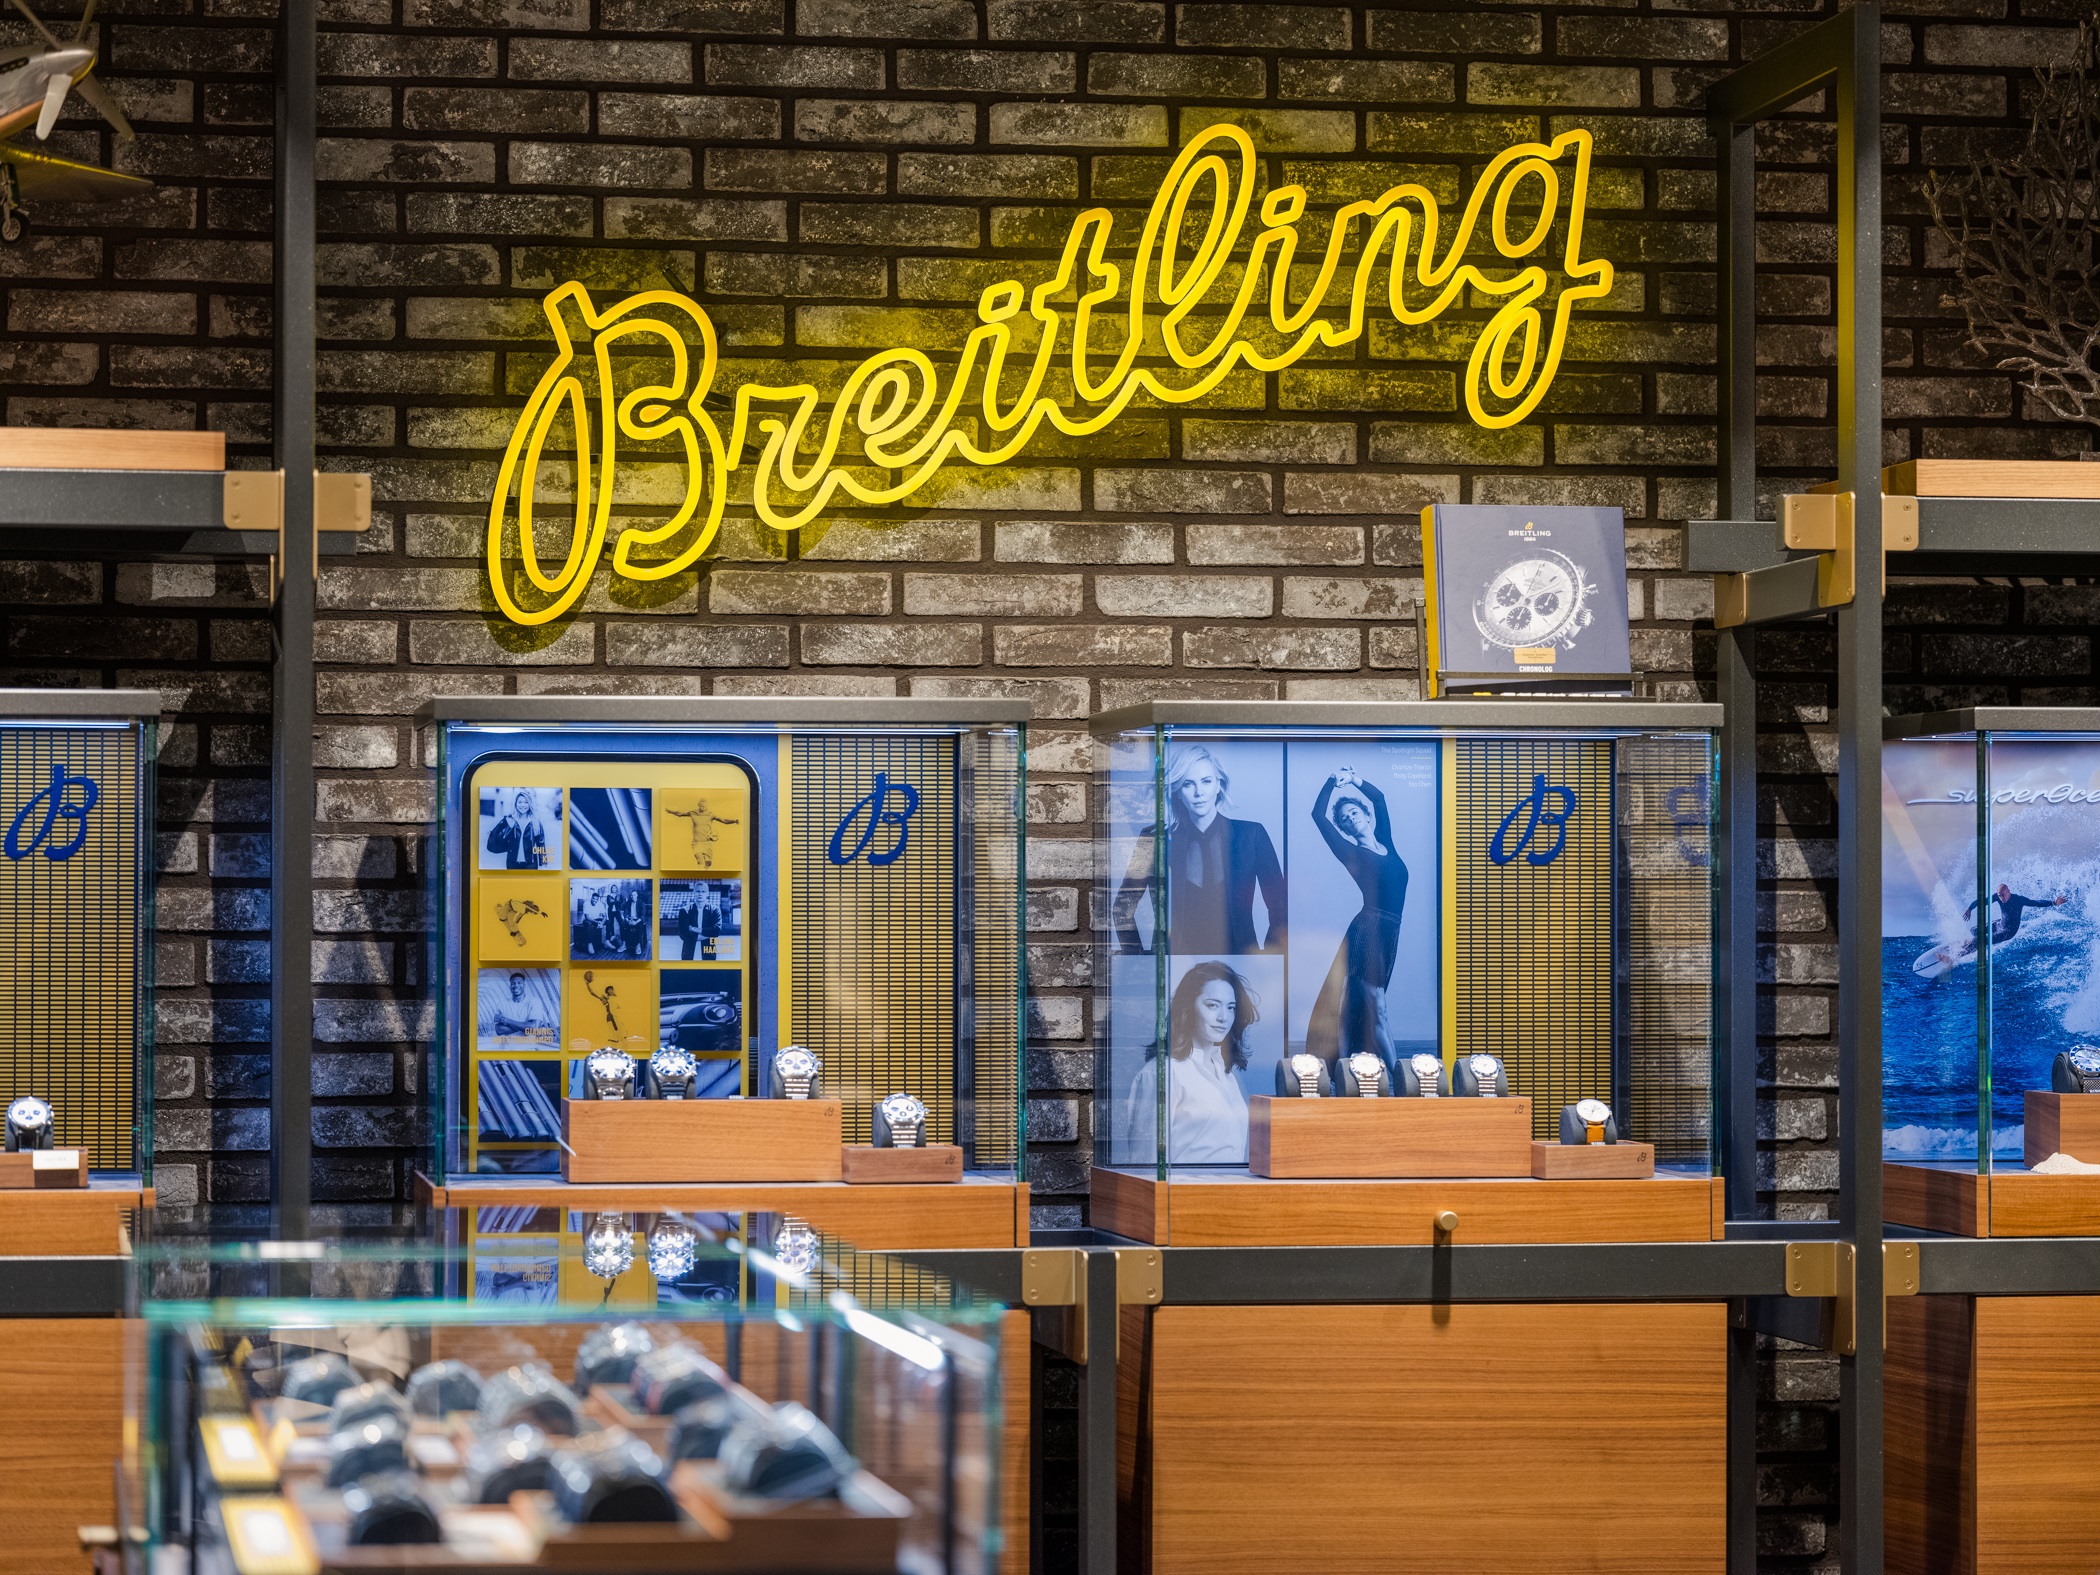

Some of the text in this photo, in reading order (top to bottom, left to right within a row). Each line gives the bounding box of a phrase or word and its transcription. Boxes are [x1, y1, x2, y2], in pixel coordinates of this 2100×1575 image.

[488, 124, 1613, 625] Breitling
[1518, 665, 1553, 673] CHRONOLOG
[524, 1027, 554, 1036] GIANNIS
